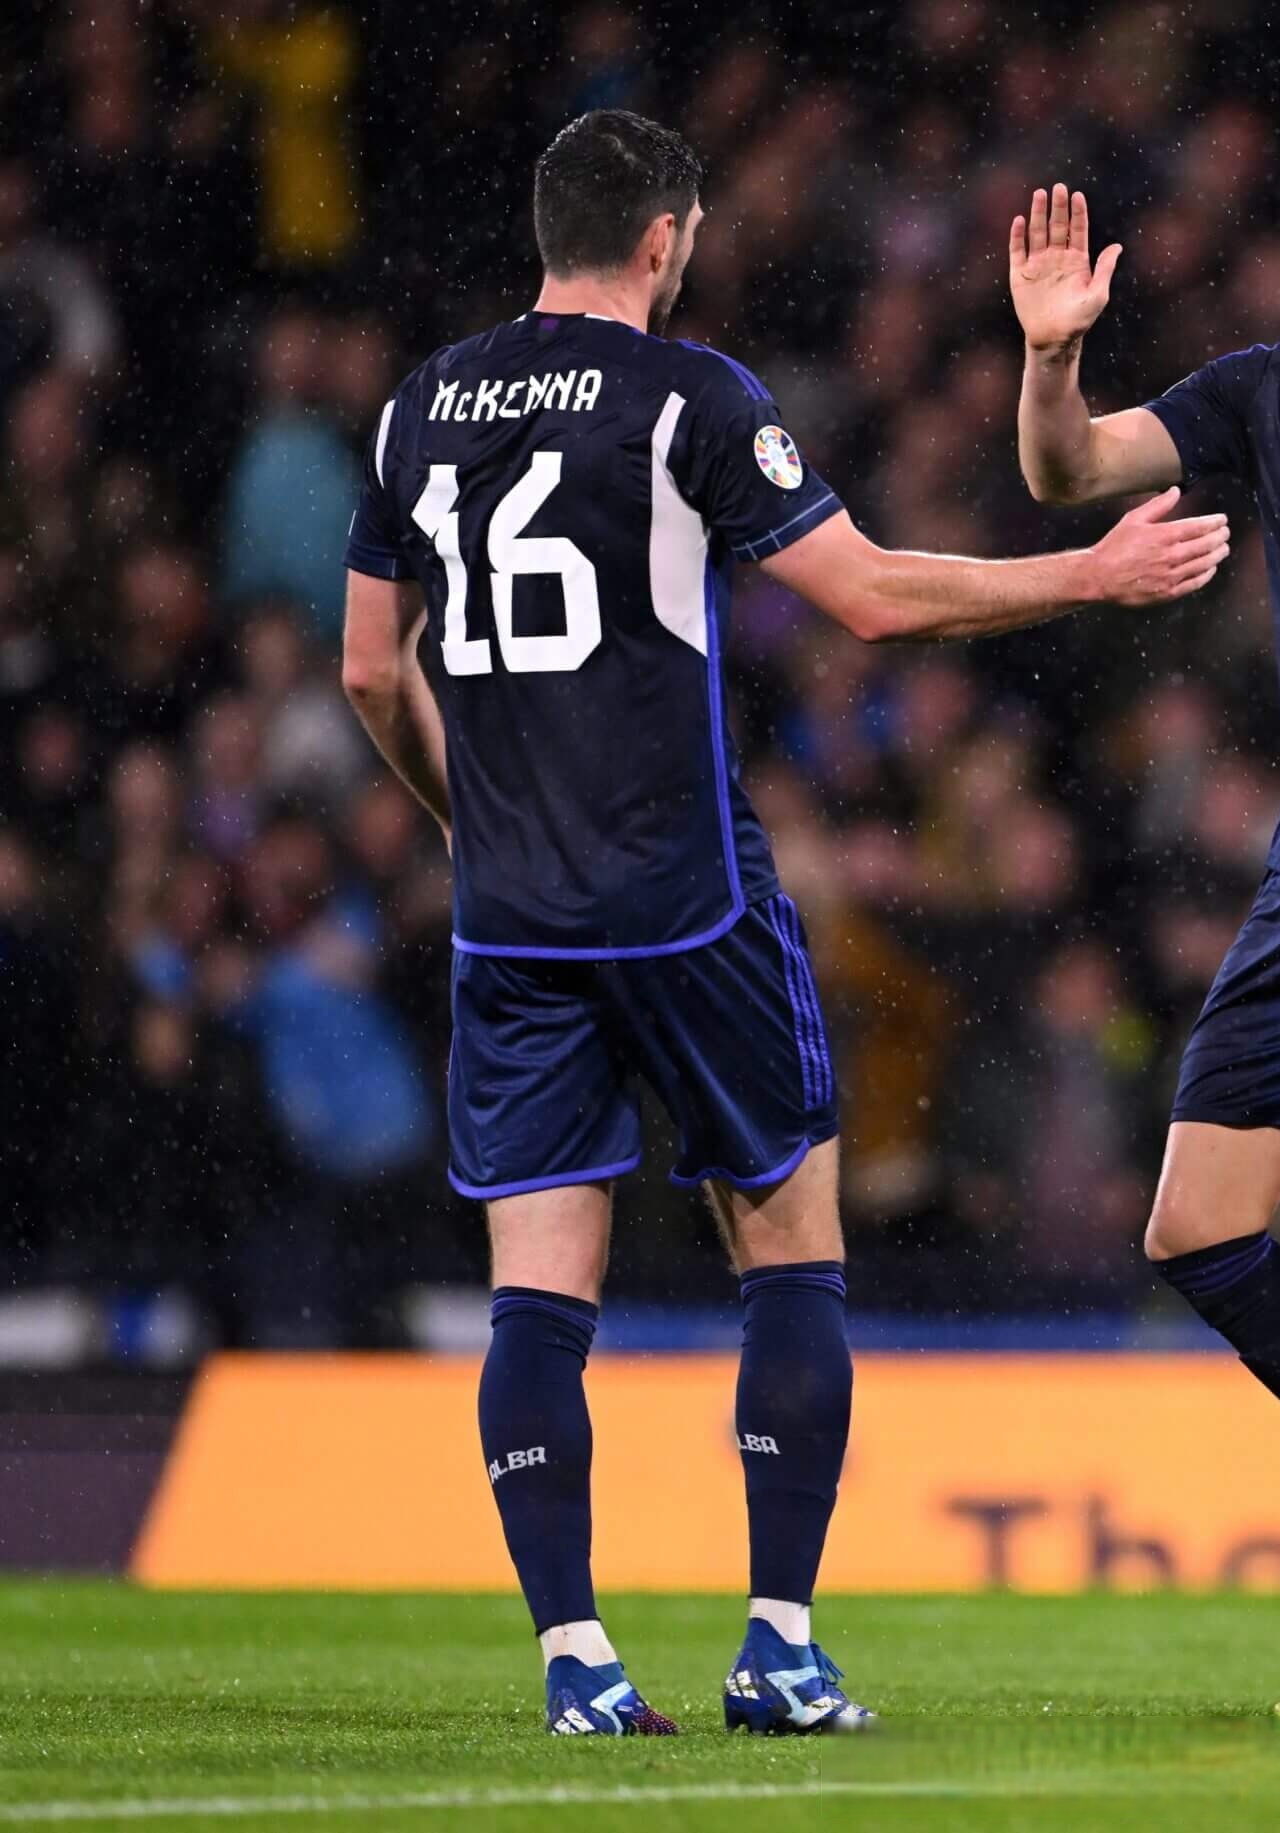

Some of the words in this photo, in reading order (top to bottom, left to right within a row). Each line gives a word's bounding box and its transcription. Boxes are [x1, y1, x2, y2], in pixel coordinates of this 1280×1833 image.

[429, 369, 602, 421] McKENNA
[411, 451, 601, 676] 16
[489, 1446, 547, 1484] ALBA
[736, 1433, 781, 1455] LBA
